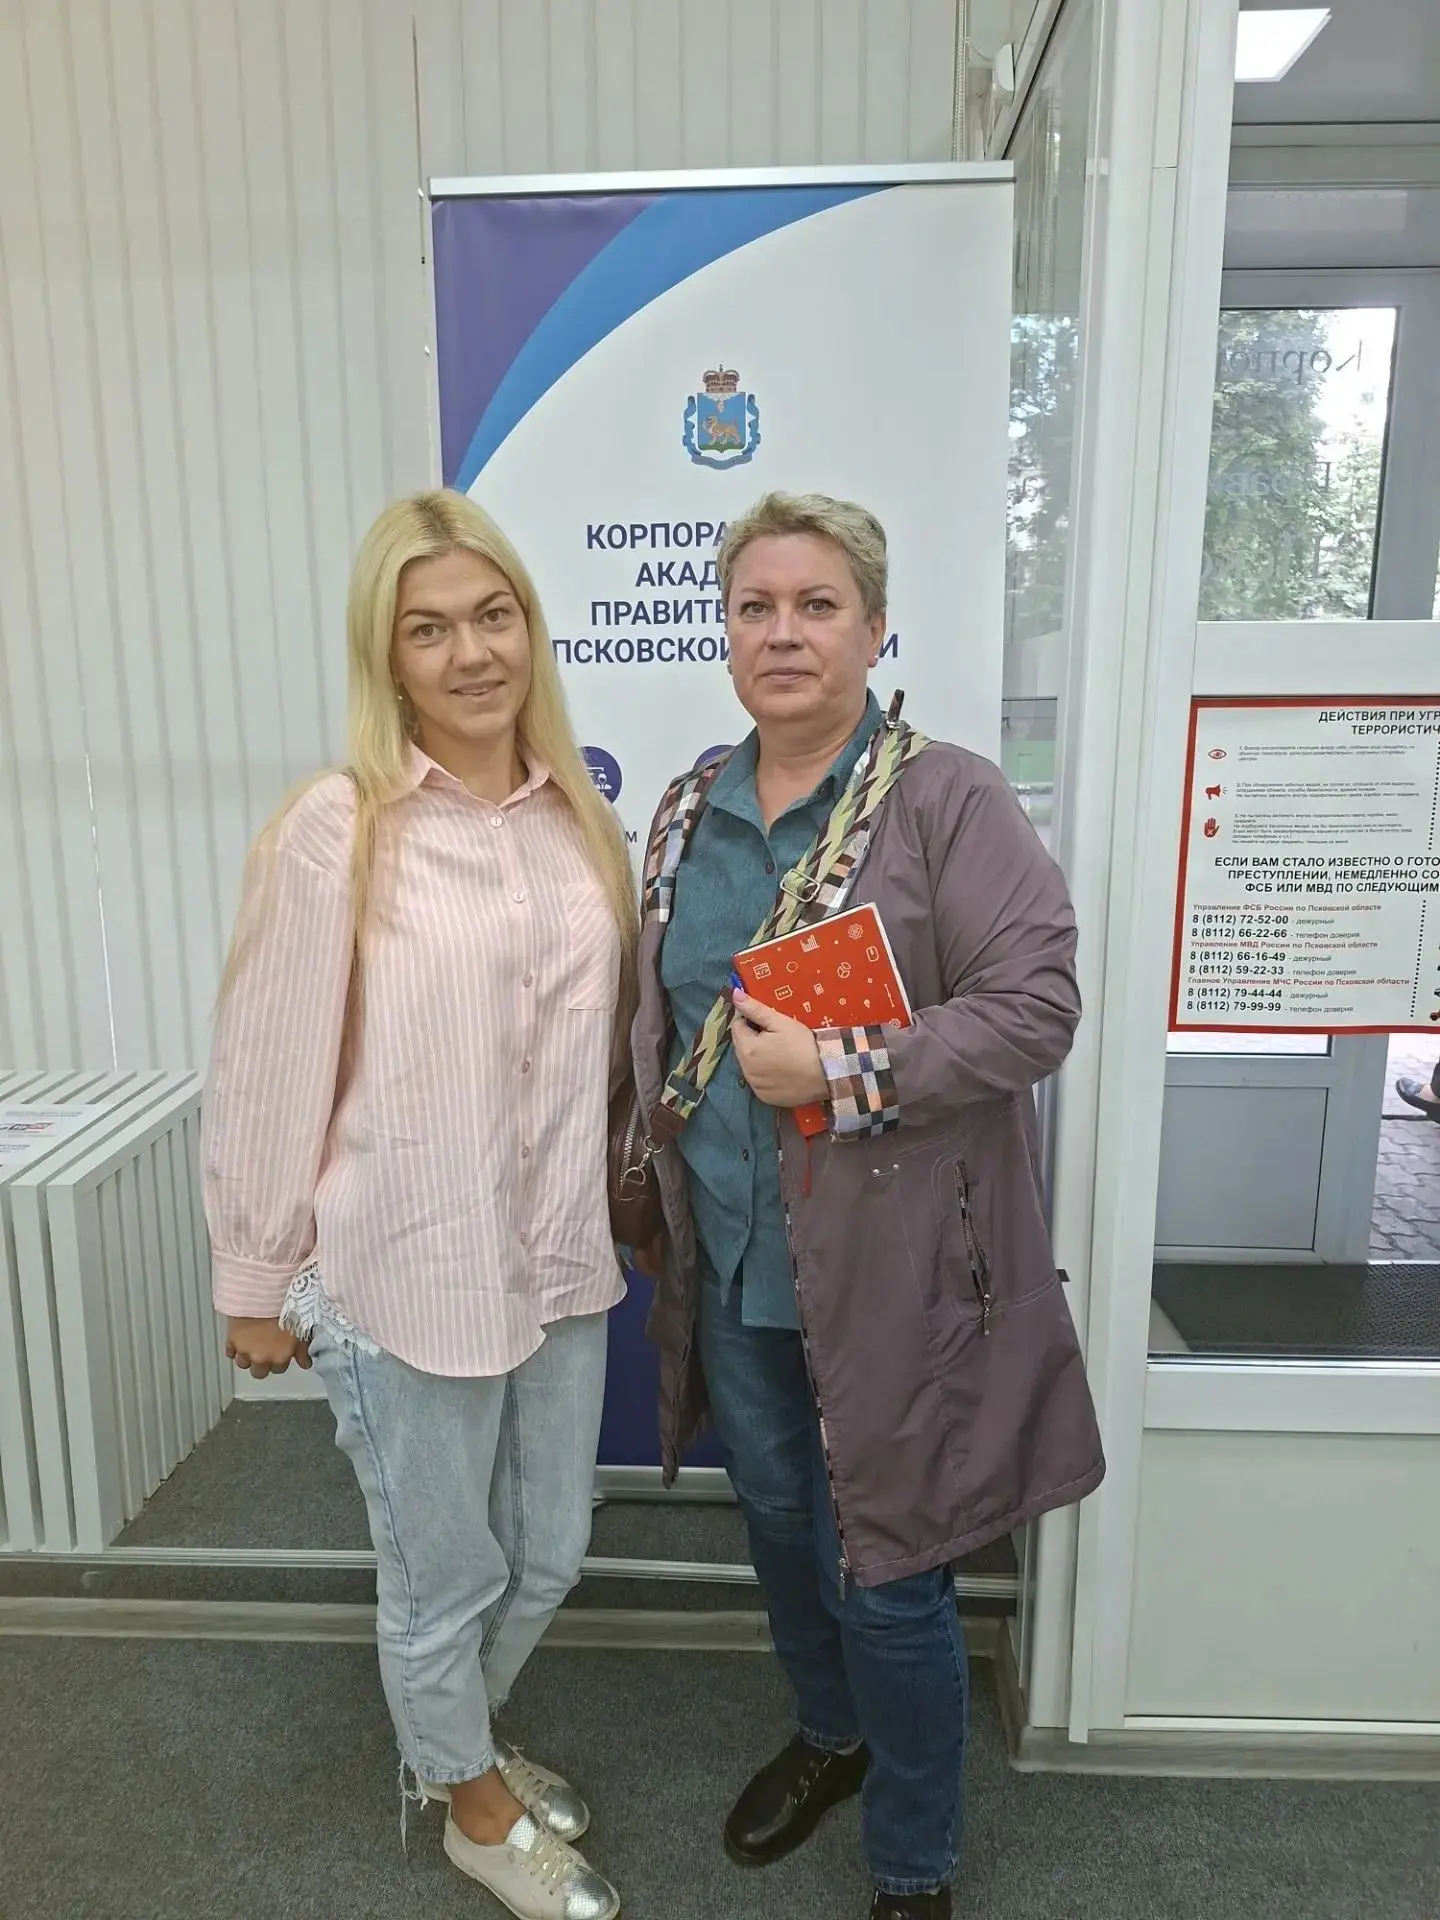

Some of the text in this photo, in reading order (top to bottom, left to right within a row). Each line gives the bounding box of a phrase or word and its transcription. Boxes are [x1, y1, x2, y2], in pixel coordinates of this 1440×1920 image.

[1319, 709, 1386, 723] ДЕЙСТВИЯ
[1390, 711, 1415, 721] ПРИ
[1352, 724, 1440, 735] ТЕРРОРИСТИЧ
[1215, 857, 1248, 866] ЕСЛИ
[1252, 857, 1279, 866] ВАМ
[1282, 857, 1325, 867] СТАЛО
[1328, 856, 1390, 866] ИЗВЕСТНО
[1394, 856, 1404, 866] О
[1228, 870, 1440, 880] ПРЕСТУПЛЕНИИ, НЕМЕДЛЕННО СО
[1245, 882, 1440, 894] ФСБ ИЛИ МВД ПО СЛЕДУЮЩИМ
[1192, 914, 1199, 924] 8
[1202, 914, 1236, 926] (8112)
[1240, 914, 1289, 924] 72-52-00
[1192, 928, 1198, 937] 8
[1202, 928, 1235, 938] (8112)
[1238, 928, 1288, 938] 66-22-66
[1190, 940, 1238, 948] Управление
[1190, 952, 1196, 960] 8
[1200, 951, 1234, 962] (8112)
[1237, 952, 1286, 962] 66-16-49
[1189, 965, 1196, 974] 8
[1198, 965, 1232, 976] (8112)
[1236, 966, 1284, 975] 59-22-33
[1222, 977, 1271, 985] Управление
[1188, 988, 1194, 996] 8
[1198, 988, 1230, 998] (8112)
[1234, 988, 1282, 998] 79-44-44
[1187, 1001, 1193, 1010] 8
[1196, 1001, 1230, 1012] (8112)
[1234, 1002, 1282, 1012] 79-99-99
